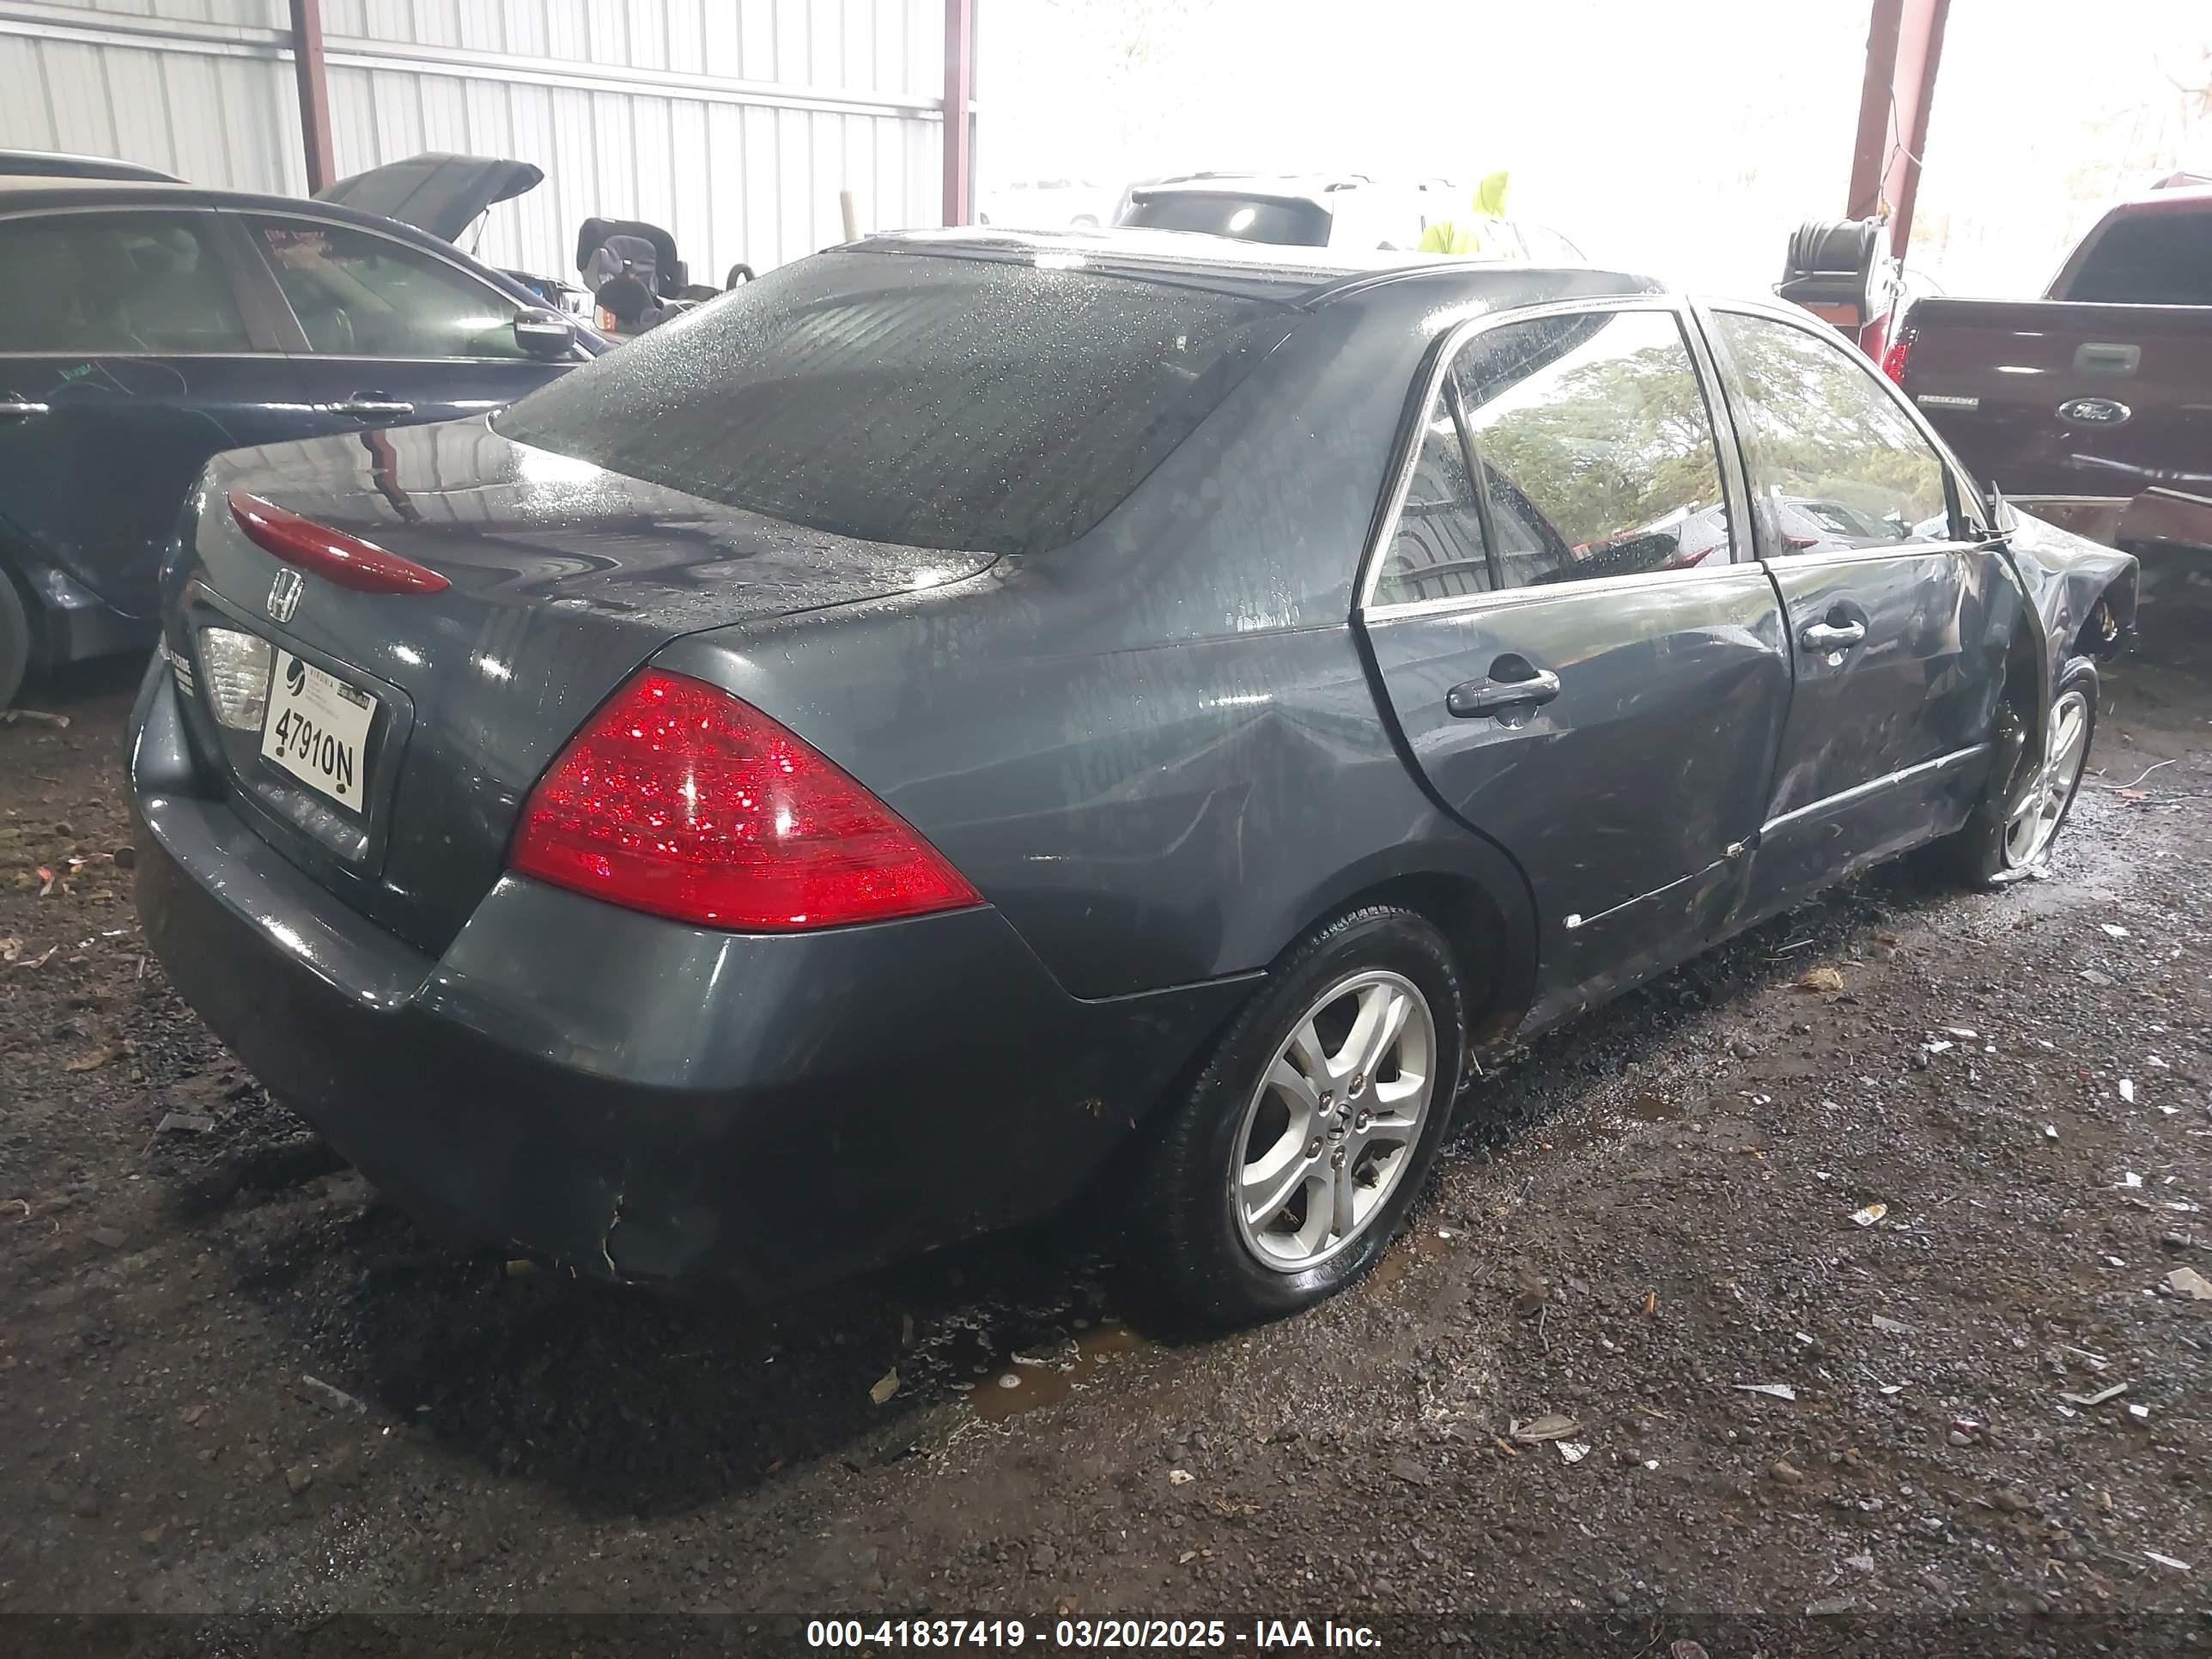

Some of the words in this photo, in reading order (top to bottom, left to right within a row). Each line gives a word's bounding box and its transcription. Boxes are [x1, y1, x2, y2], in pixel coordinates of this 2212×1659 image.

[2073, 403, 2112, 420] Ford
[309, 666, 335, 689] VIRGA
[275, 707, 354, 787] 47910N
